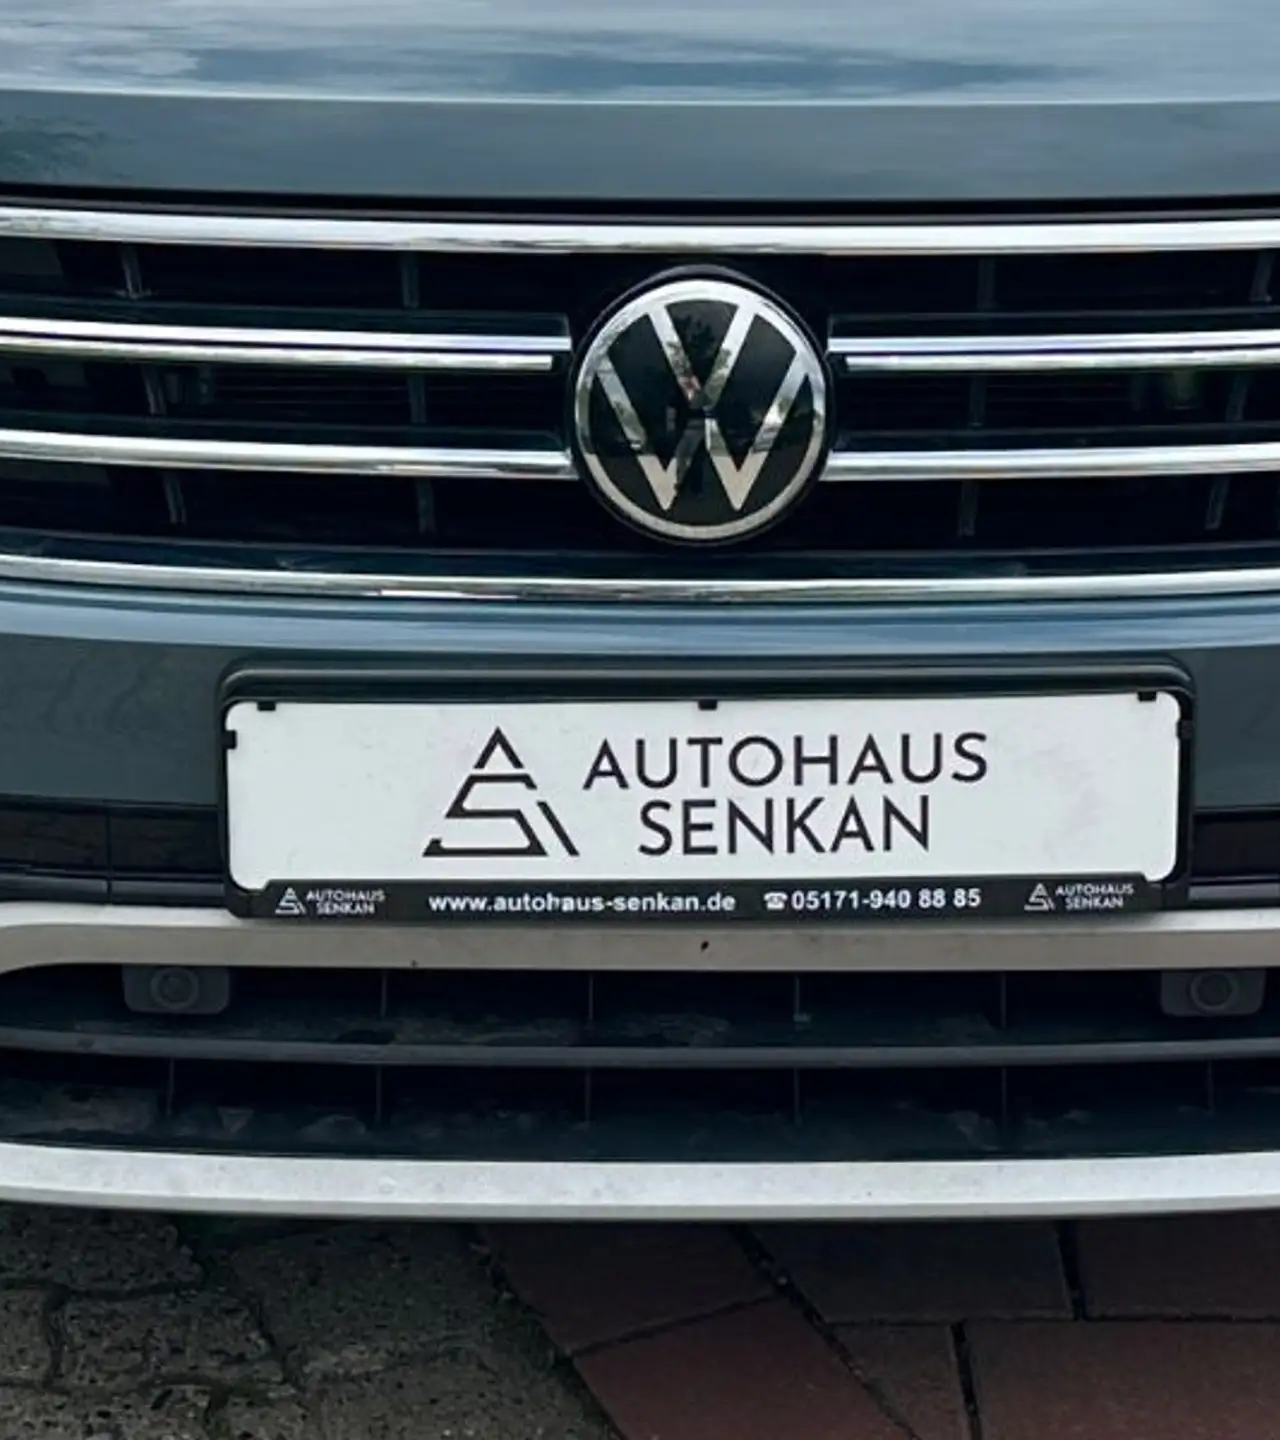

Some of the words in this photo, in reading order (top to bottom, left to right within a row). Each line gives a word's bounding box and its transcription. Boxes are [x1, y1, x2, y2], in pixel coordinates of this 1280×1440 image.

[582, 731, 988, 791] AUTOHAUS
[637, 794, 929, 856] SENKAN
[306, 889, 385, 903] AUTOHAUS
[1055, 883, 1134, 896] AUTOHAUS
[428, 892, 736, 912] www.autohaus-senkan.de
[791, 890, 912, 911] 05171-940
[918, 888, 946, 909] 88
[953, 888, 982, 908] 85
[1065, 896, 1124, 910] SENKAN
[316, 902, 375, 915] SENKAN
